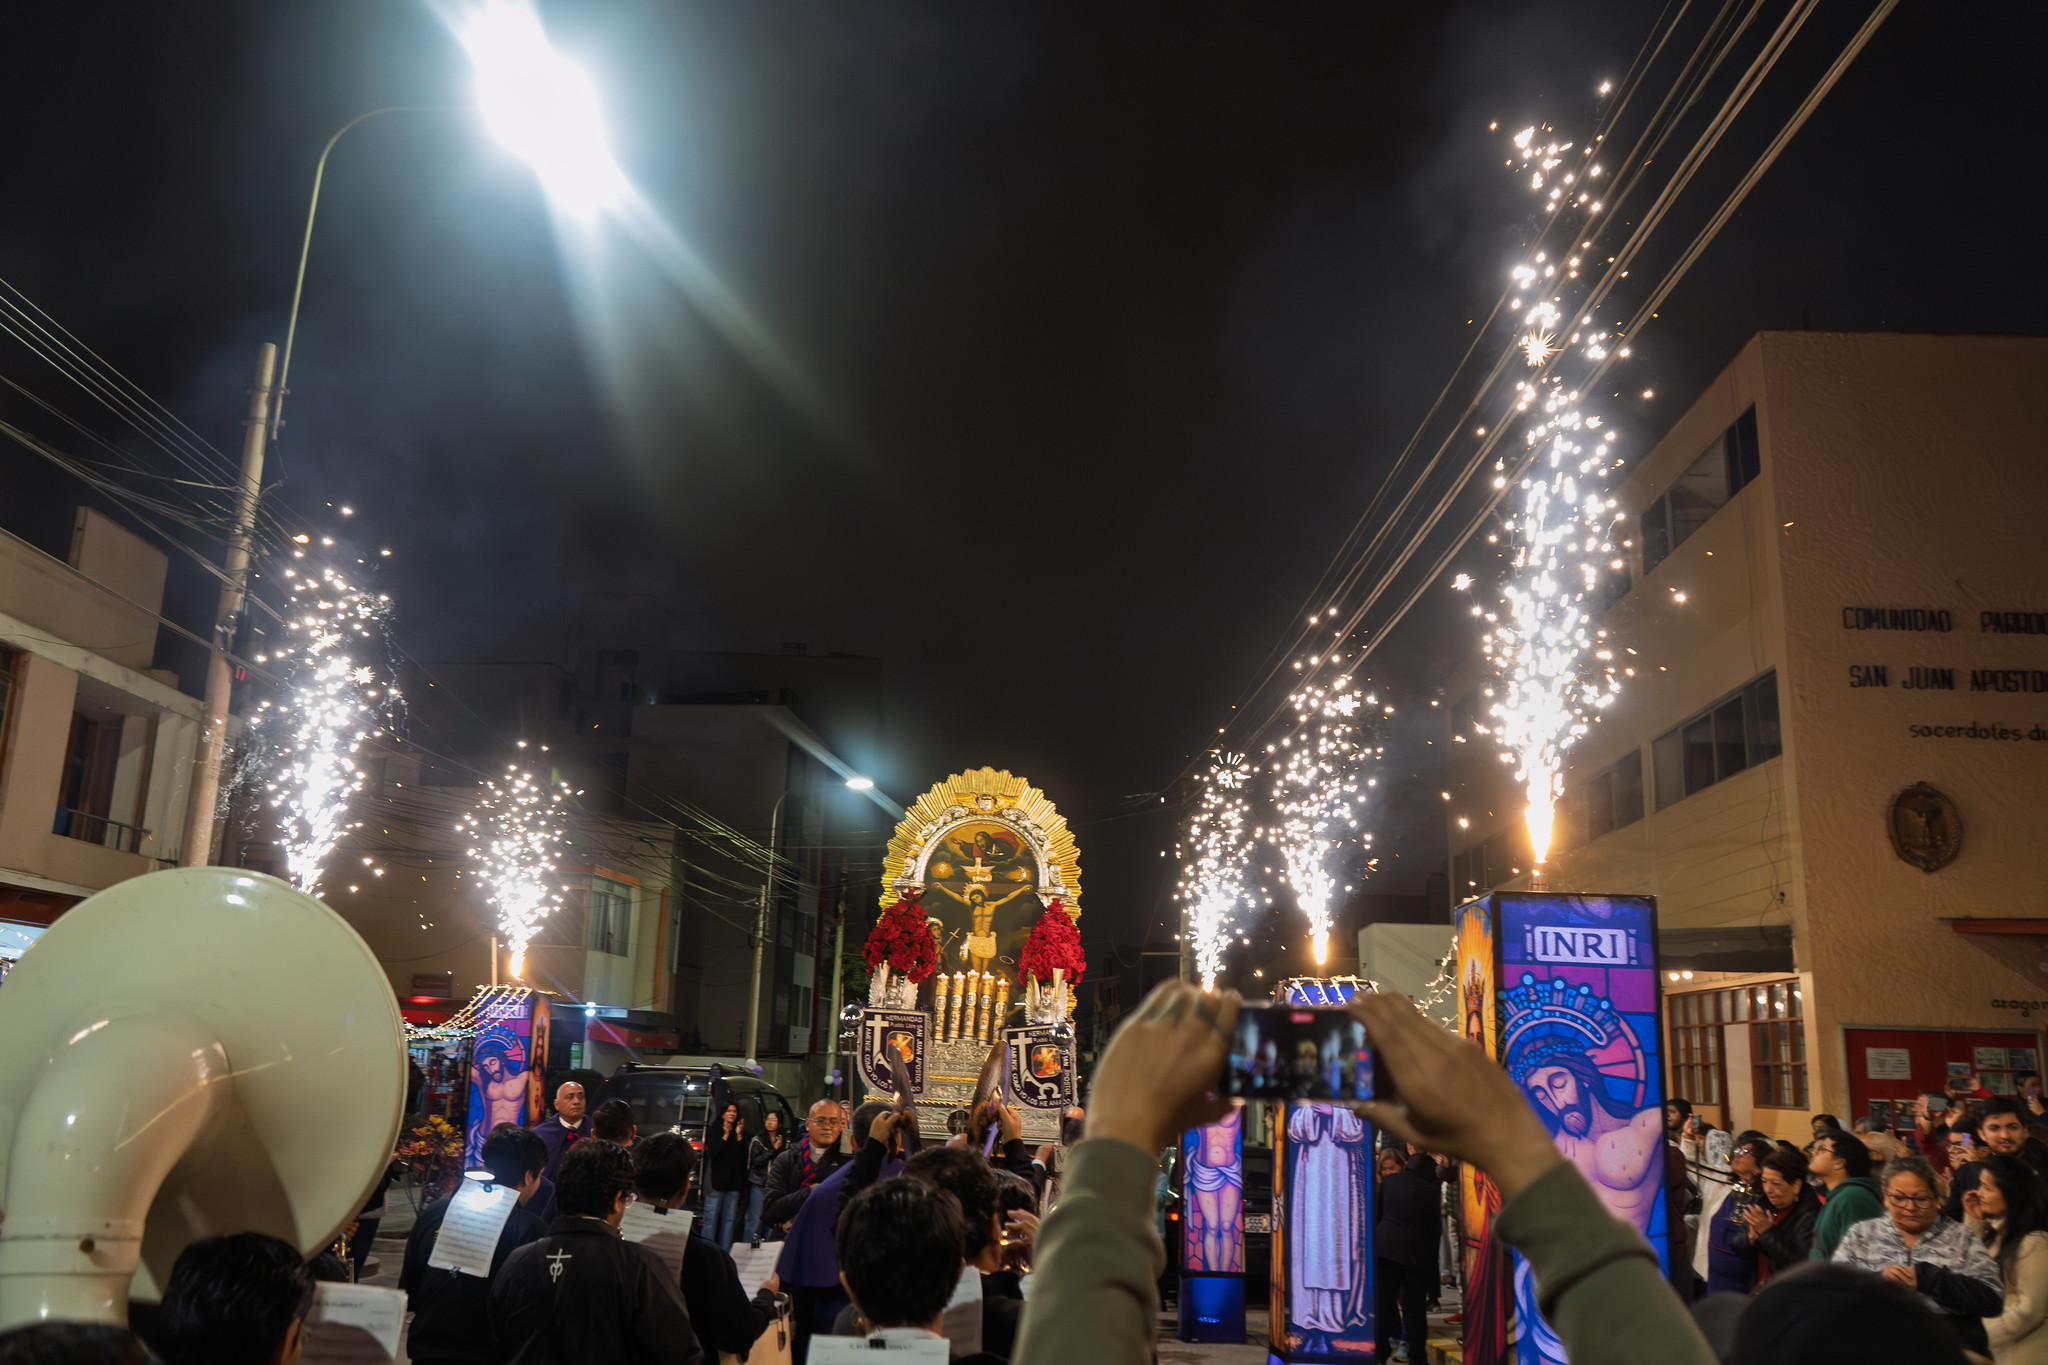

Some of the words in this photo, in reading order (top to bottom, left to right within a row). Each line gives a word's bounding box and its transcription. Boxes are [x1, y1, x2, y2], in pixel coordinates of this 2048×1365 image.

[1841, 607, 1953, 633] COMUNIDAD
[1849, 664, 1889, 688] SAN
[1902, 666, 1955, 690] JUAN
[1540, 930, 1620, 958] INRI
[1039, 1099, 1048, 1107] HE
